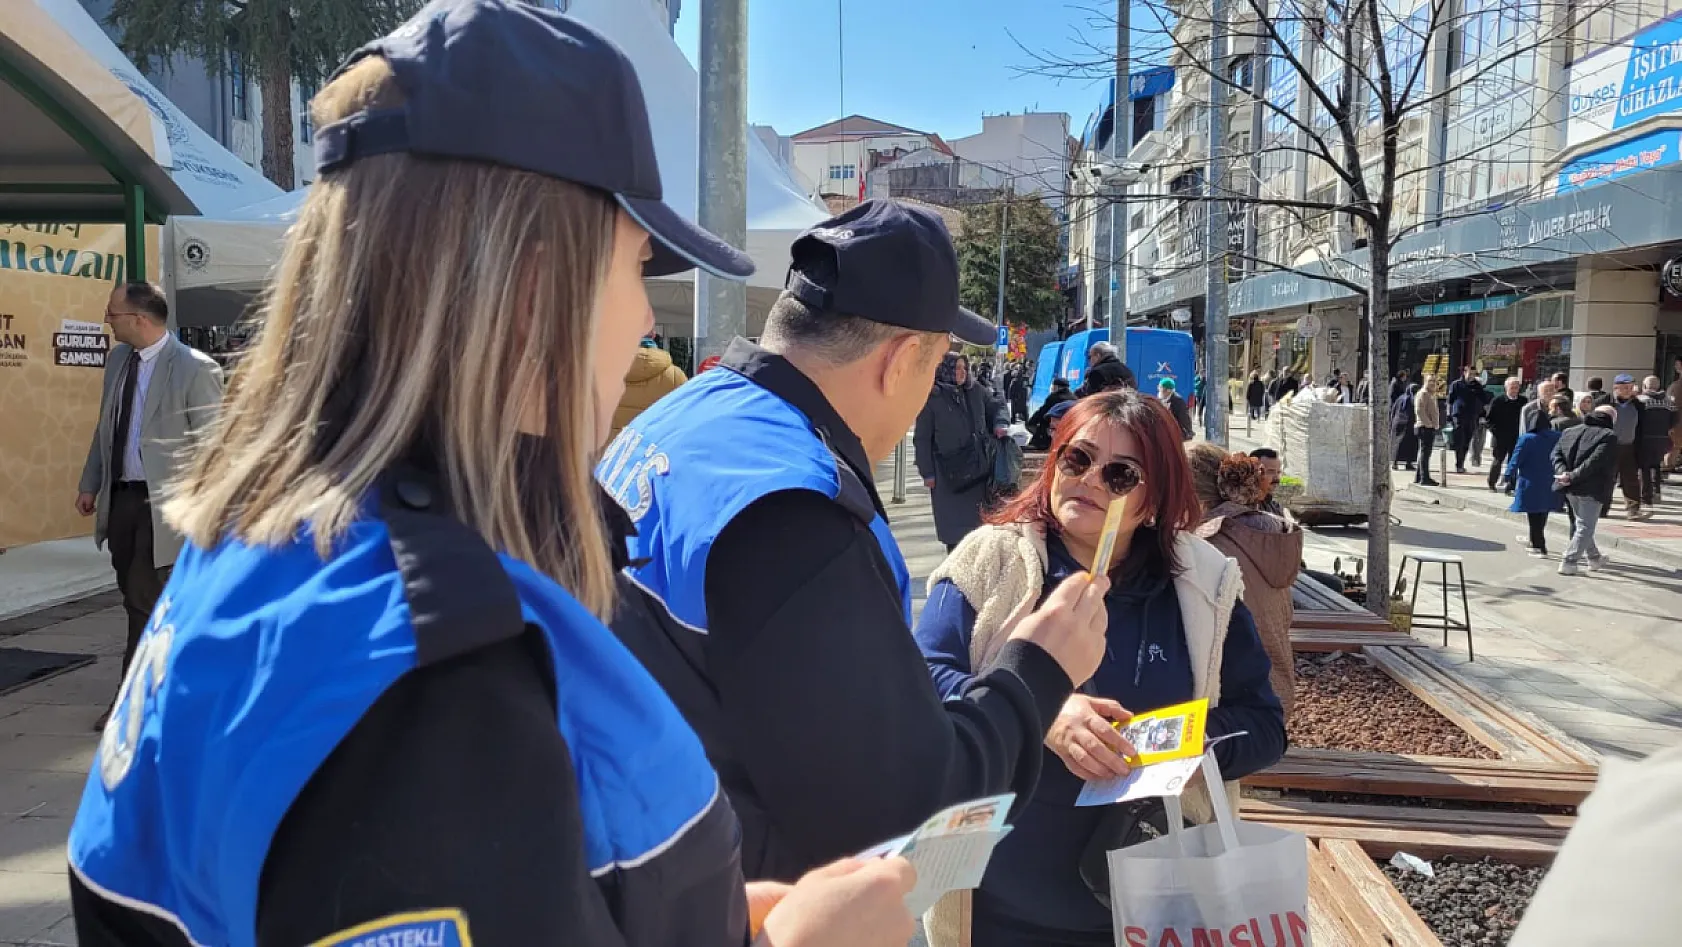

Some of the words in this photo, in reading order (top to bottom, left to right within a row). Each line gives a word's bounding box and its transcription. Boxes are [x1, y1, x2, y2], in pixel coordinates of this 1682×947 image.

[1634, 39, 1682, 80] İŞİTM
[0, 239, 124, 288] mazan
[56, 334, 107, 349] GURURLA
[60, 351, 104, 366] SAMSUN
